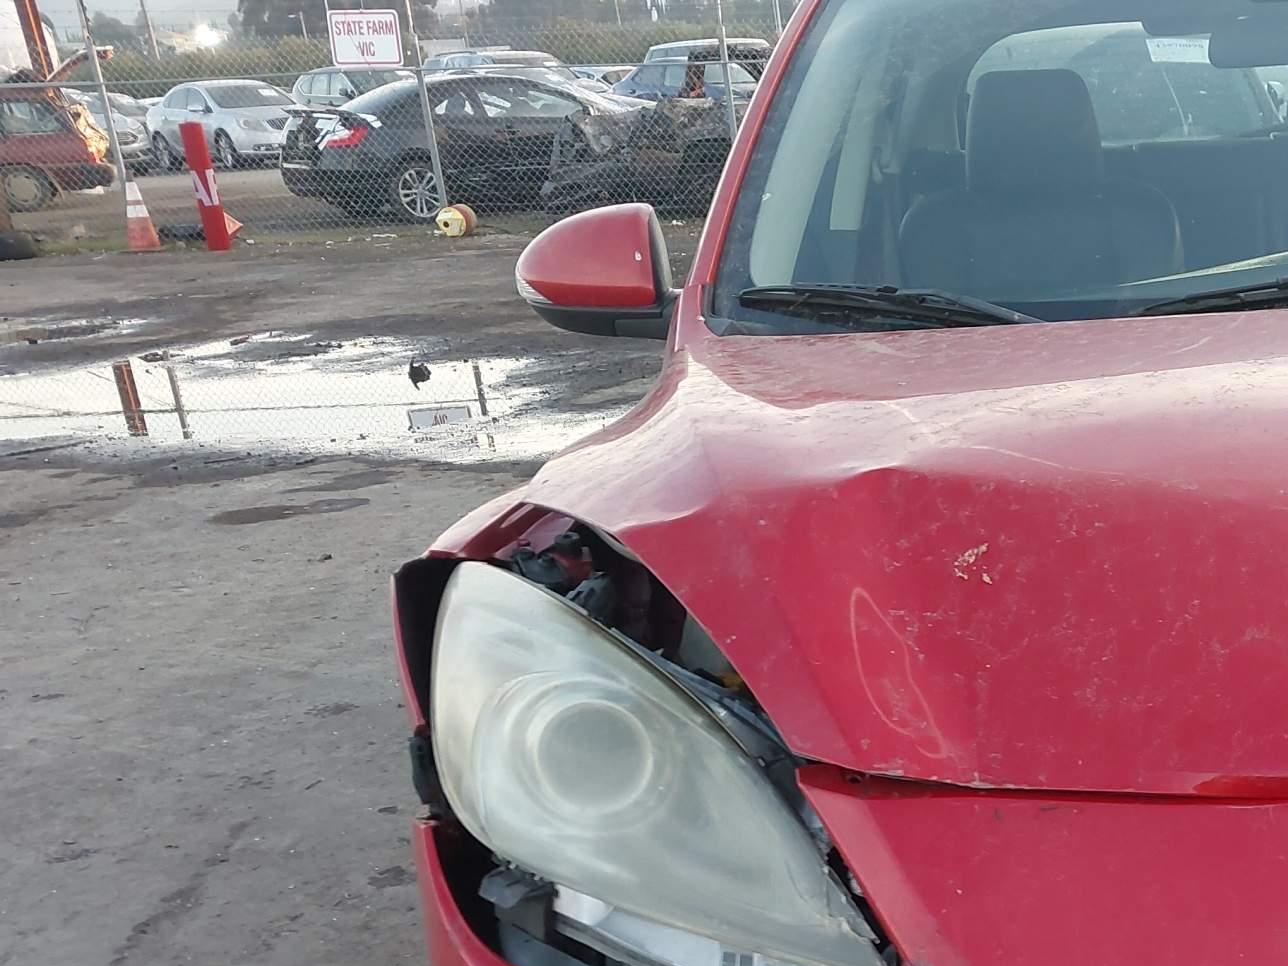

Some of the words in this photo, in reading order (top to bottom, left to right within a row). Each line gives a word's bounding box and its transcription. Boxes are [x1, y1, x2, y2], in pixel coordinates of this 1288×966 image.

[334, 20, 365, 36] STATE
[366, 20, 394, 36] FARM
[359, 41, 376, 57] VIC
